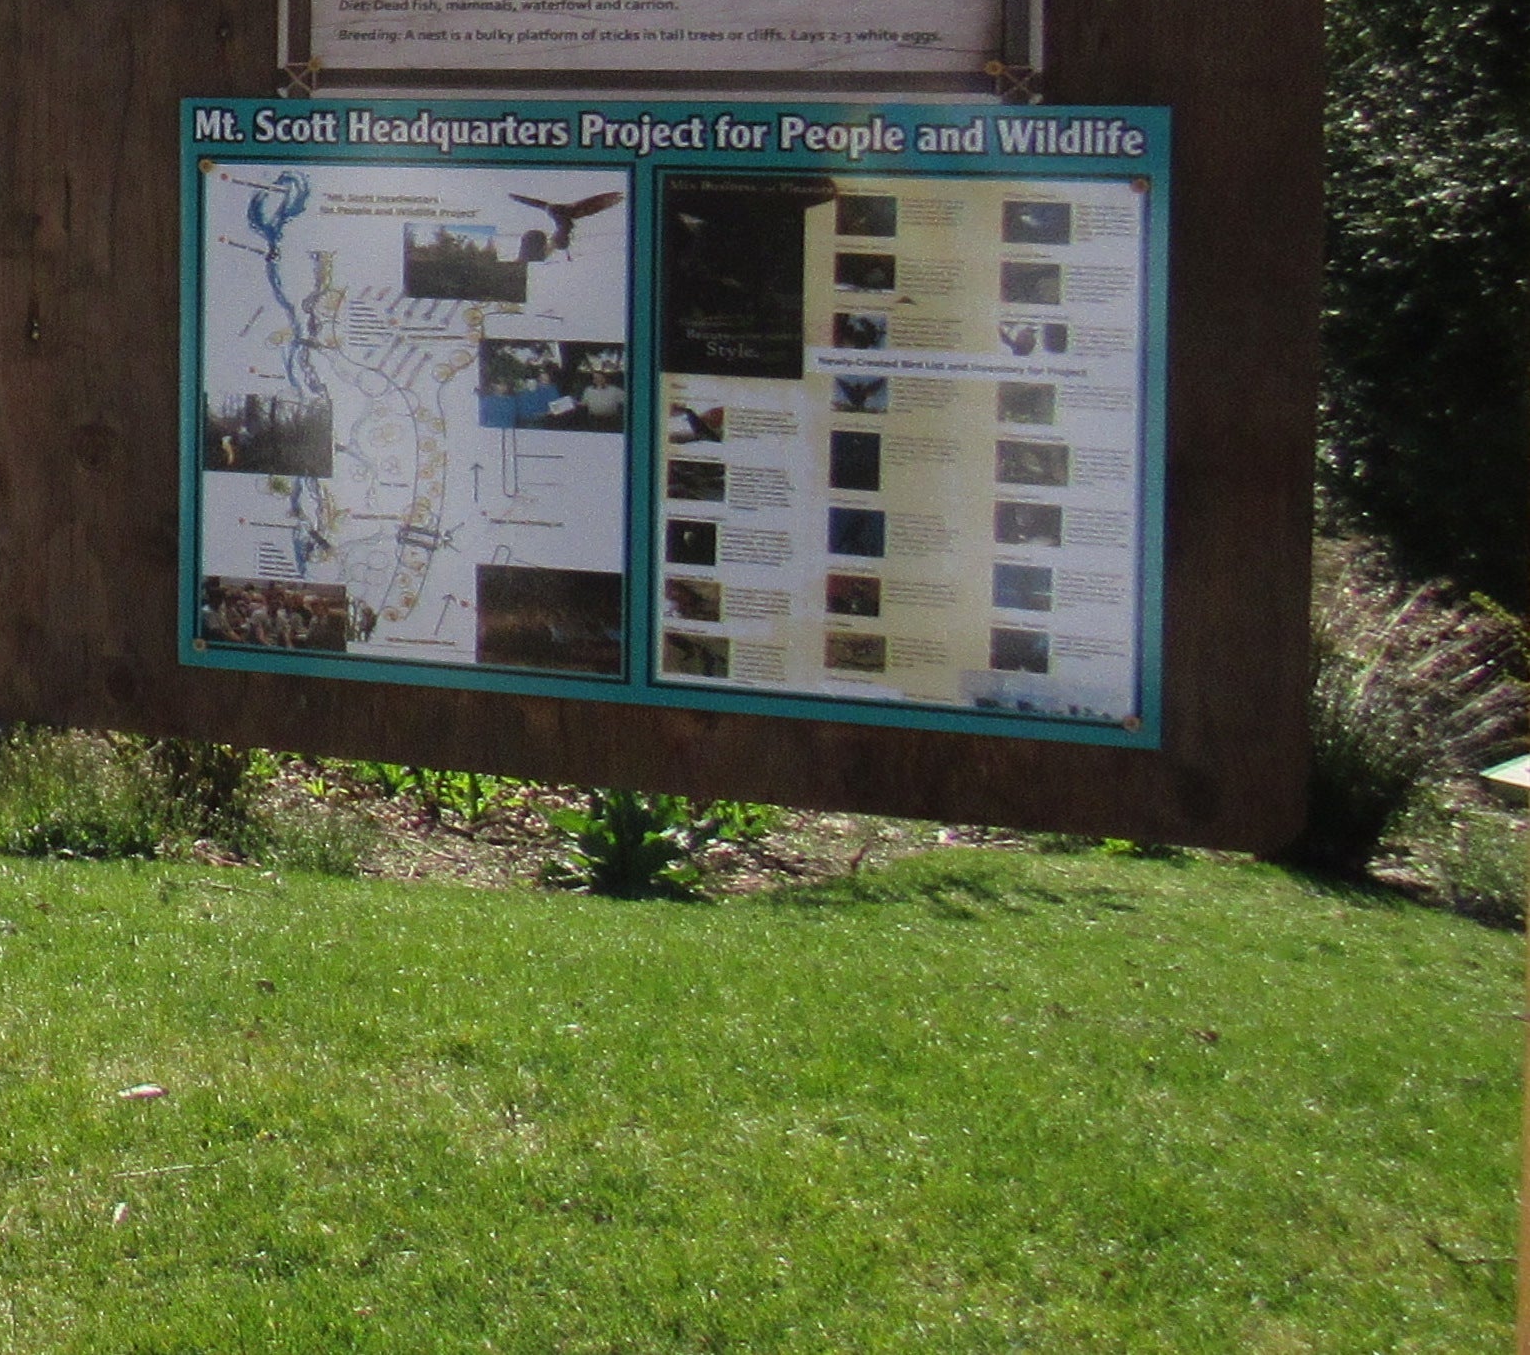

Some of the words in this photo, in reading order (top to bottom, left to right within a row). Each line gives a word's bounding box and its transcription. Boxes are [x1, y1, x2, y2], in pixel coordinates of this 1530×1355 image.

[373, 0, 409, 11] Dead
[521, 0, 592, 10] waterfowl
[595, 0, 622, 10] and
[404, 29, 415, 41] A
[417, 31, 447, 41] nest
[450, 29, 461, 41] is
[464, 33, 473, 41] a
[475, 30, 513, 44] bulky
[517, 30, 578, 44] platform
[581, 30, 596, 41] of
[600, 30, 640, 41] sticks
[643, 30, 657, 41] in
[660, 30, 685, 41] tall
[688, 31, 724, 41] trees
[728, 33, 743, 41] or
[790, 30, 825, 44] Lays
[854, 30, 898, 41] white
[195, 109, 244, 141] Mt.
[255, 109, 338, 143] Scott
[349, 110, 570, 152] Headquarters
[581, 114, 703, 156] Project
[715, 115, 769, 148] for
[779, 116, 905, 159] People
[917, 118, 984, 153] and
[998, 118, 1144, 156] Wildlife
[948, 363, 969, 371] and
